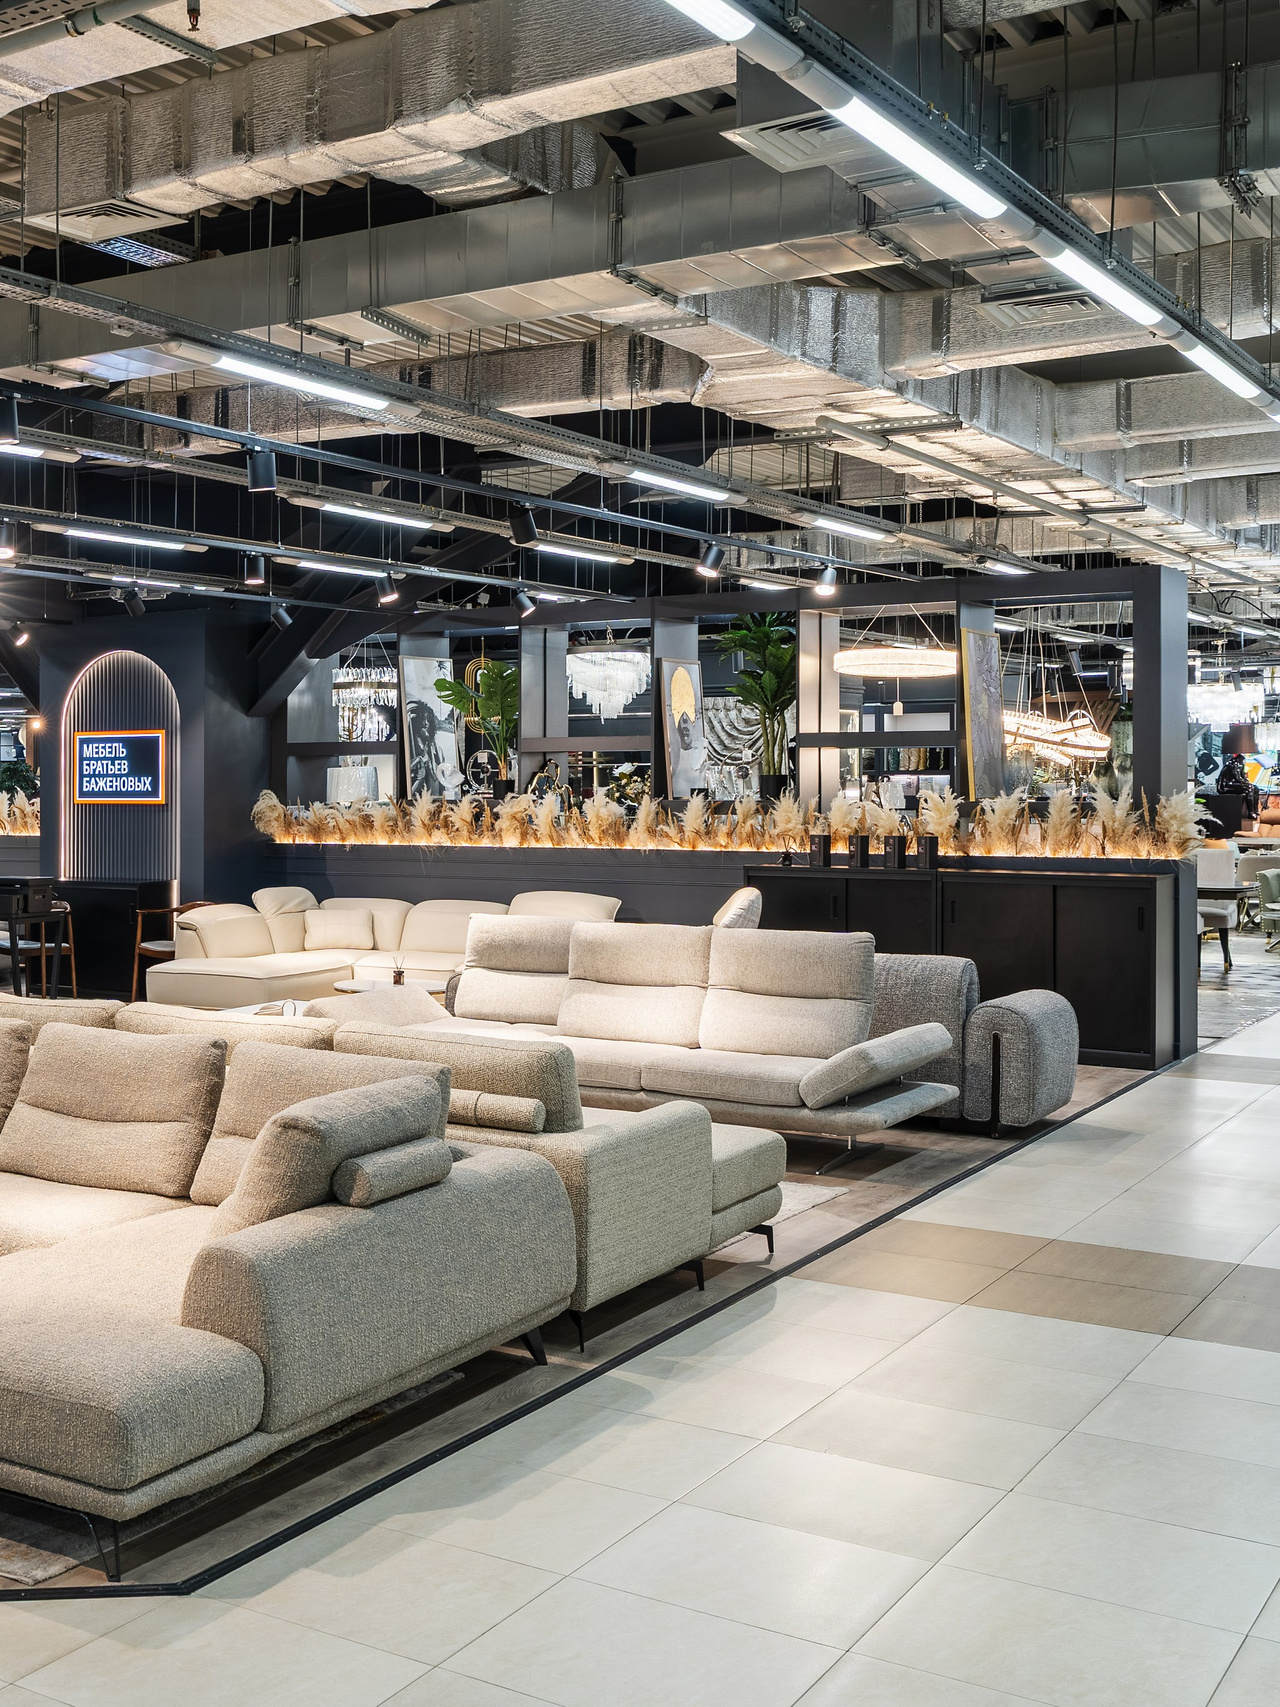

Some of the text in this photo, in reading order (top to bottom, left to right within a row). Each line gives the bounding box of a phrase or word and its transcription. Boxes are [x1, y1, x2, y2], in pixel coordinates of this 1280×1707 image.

[83, 743, 126, 758] МЕБЕЛЬ
[83, 760, 128, 775] БРАТЬЕВ
[83, 777, 152, 792] БАЖЕНОВЫХ
